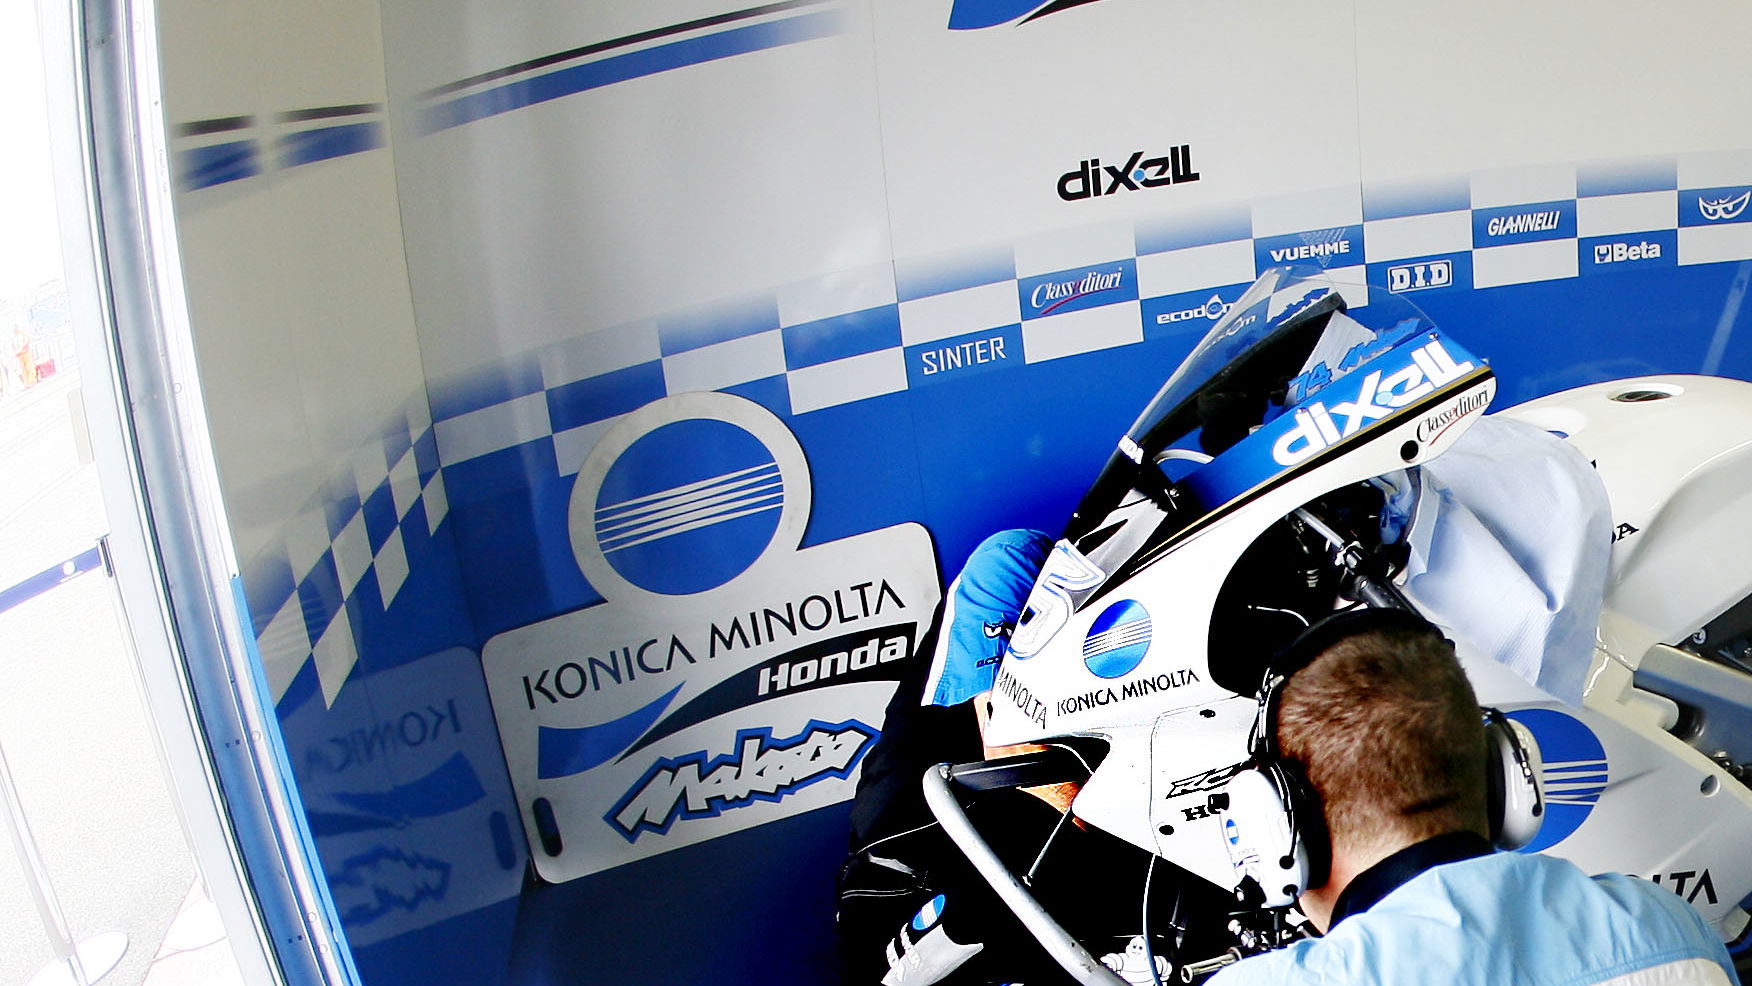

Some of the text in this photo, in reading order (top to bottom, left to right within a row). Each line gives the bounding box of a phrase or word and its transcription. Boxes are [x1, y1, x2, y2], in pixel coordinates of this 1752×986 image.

[1057, 145, 1200, 202] dixell
[1487, 210, 1561, 237] GIANNELLI
[1269, 240, 1351, 264] VUEMME
[1612, 240, 1662, 263] Beta
[922, 336, 1007, 376] SINTER
[522, 578, 906, 711] KONICA MINOLTA
[757, 633, 908, 697] Honda
[1057, 667, 1201, 717] KONICA MINOLTA
